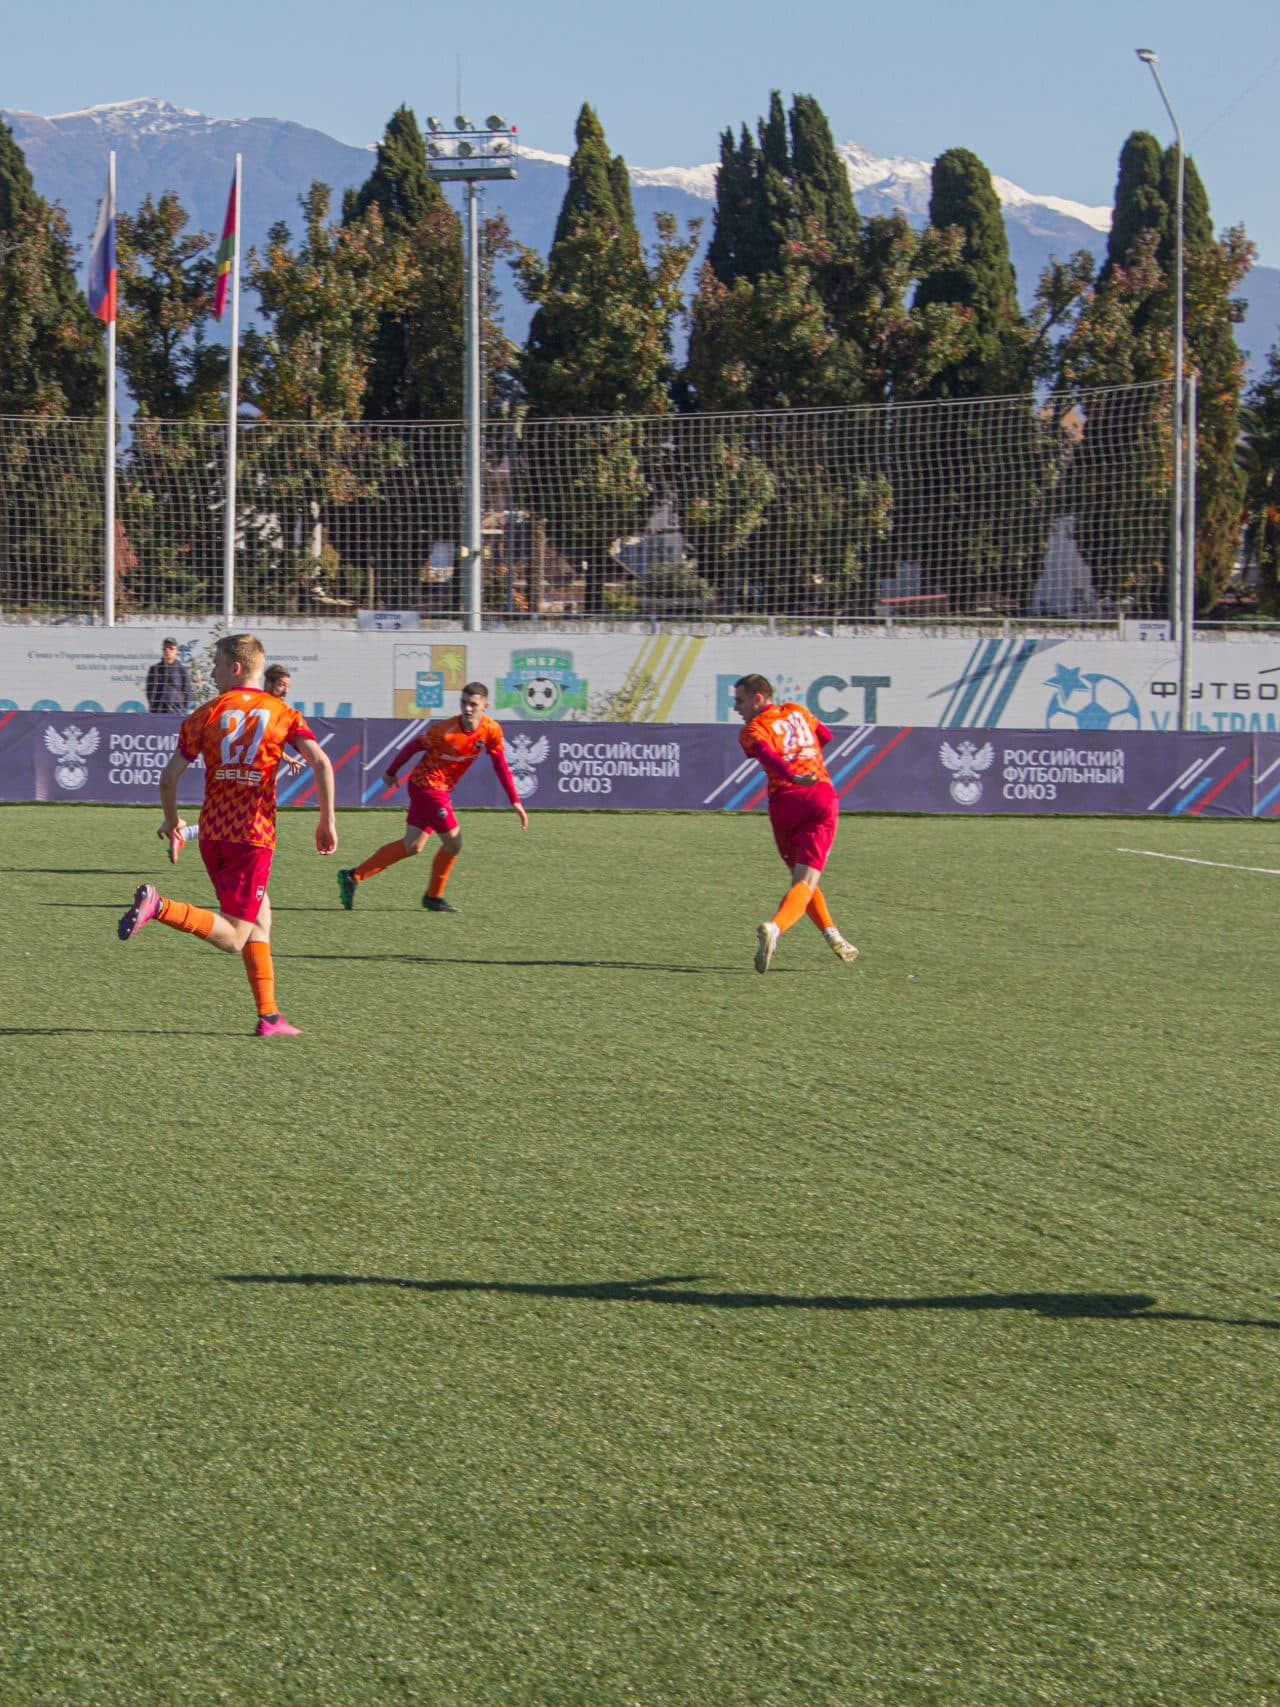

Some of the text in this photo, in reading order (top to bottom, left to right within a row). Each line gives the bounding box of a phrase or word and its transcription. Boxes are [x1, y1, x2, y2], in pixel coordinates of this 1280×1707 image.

[221, 709, 271, 766] 27
[559, 742, 680, 760] РОССИЙСКИЙ
[1003, 748, 1125, 766] РОССИЙСКИЙ
[558, 760, 680, 777] ФУТБОЛЬНЫЙ
[1003, 766, 1125, 784] ФУТБОЛЬНЫЙ
[109, 769, 161, 786] СОЮЗ
[558, 777, 612, 794] СОЮЗ
[1003, 783, 1057, 800] СОЮЗ
